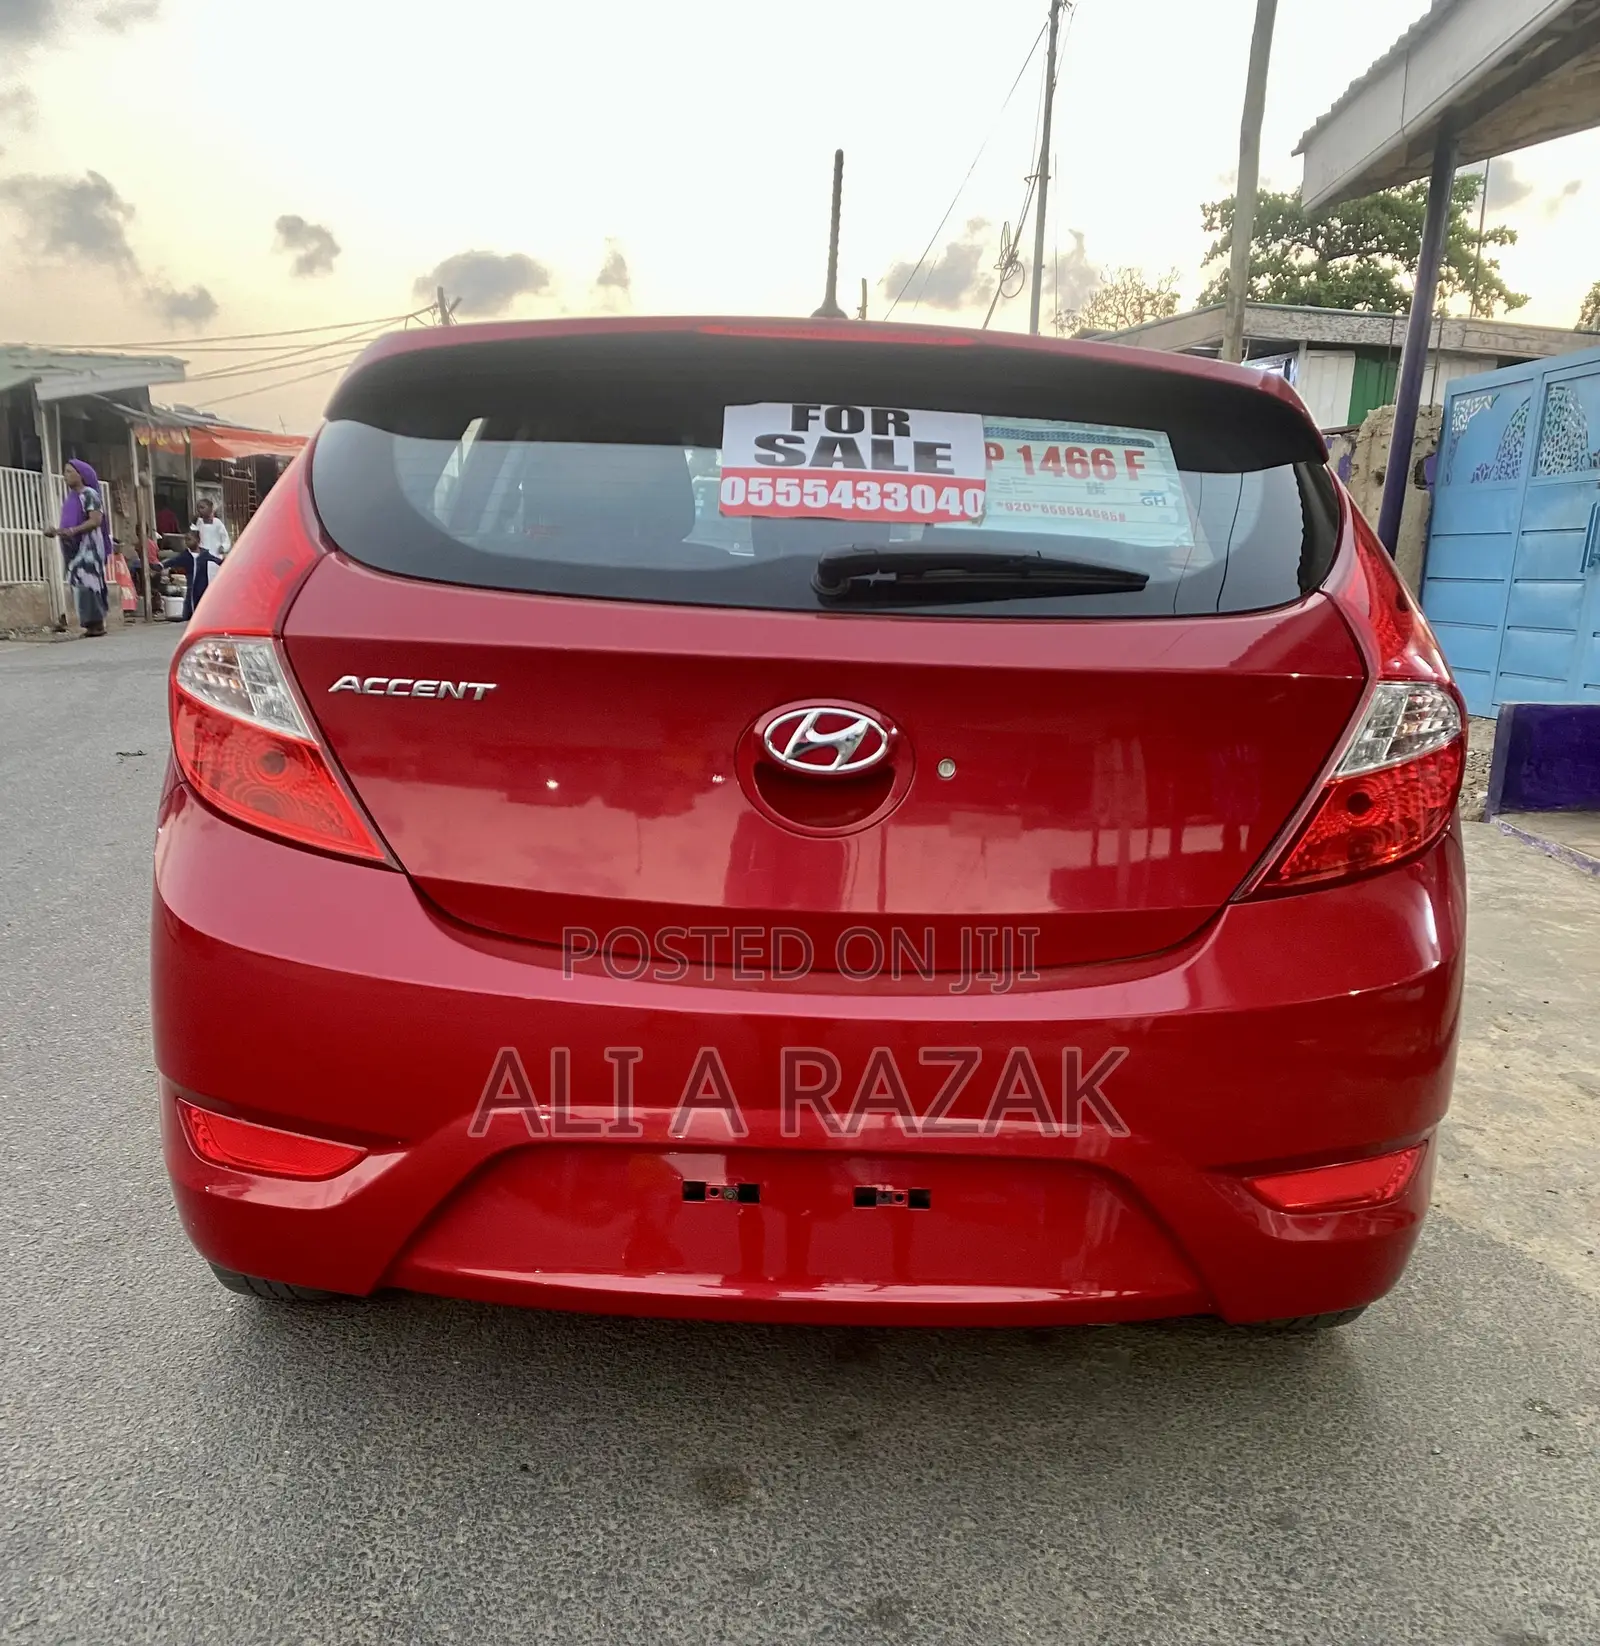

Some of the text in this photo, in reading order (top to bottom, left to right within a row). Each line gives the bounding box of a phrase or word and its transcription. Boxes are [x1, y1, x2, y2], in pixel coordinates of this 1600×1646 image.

[791, 404, 910, 437] FOR
[754, 433, 954, 475] SALE
[1017, 445, 1118, 481] 1466
[1124, 449, 1145, 481] F
[720, 476, 985, 518] 0555433040
[1141, 496, 1167, 507] GH
[328, 675, 497, 700] ACCENT
